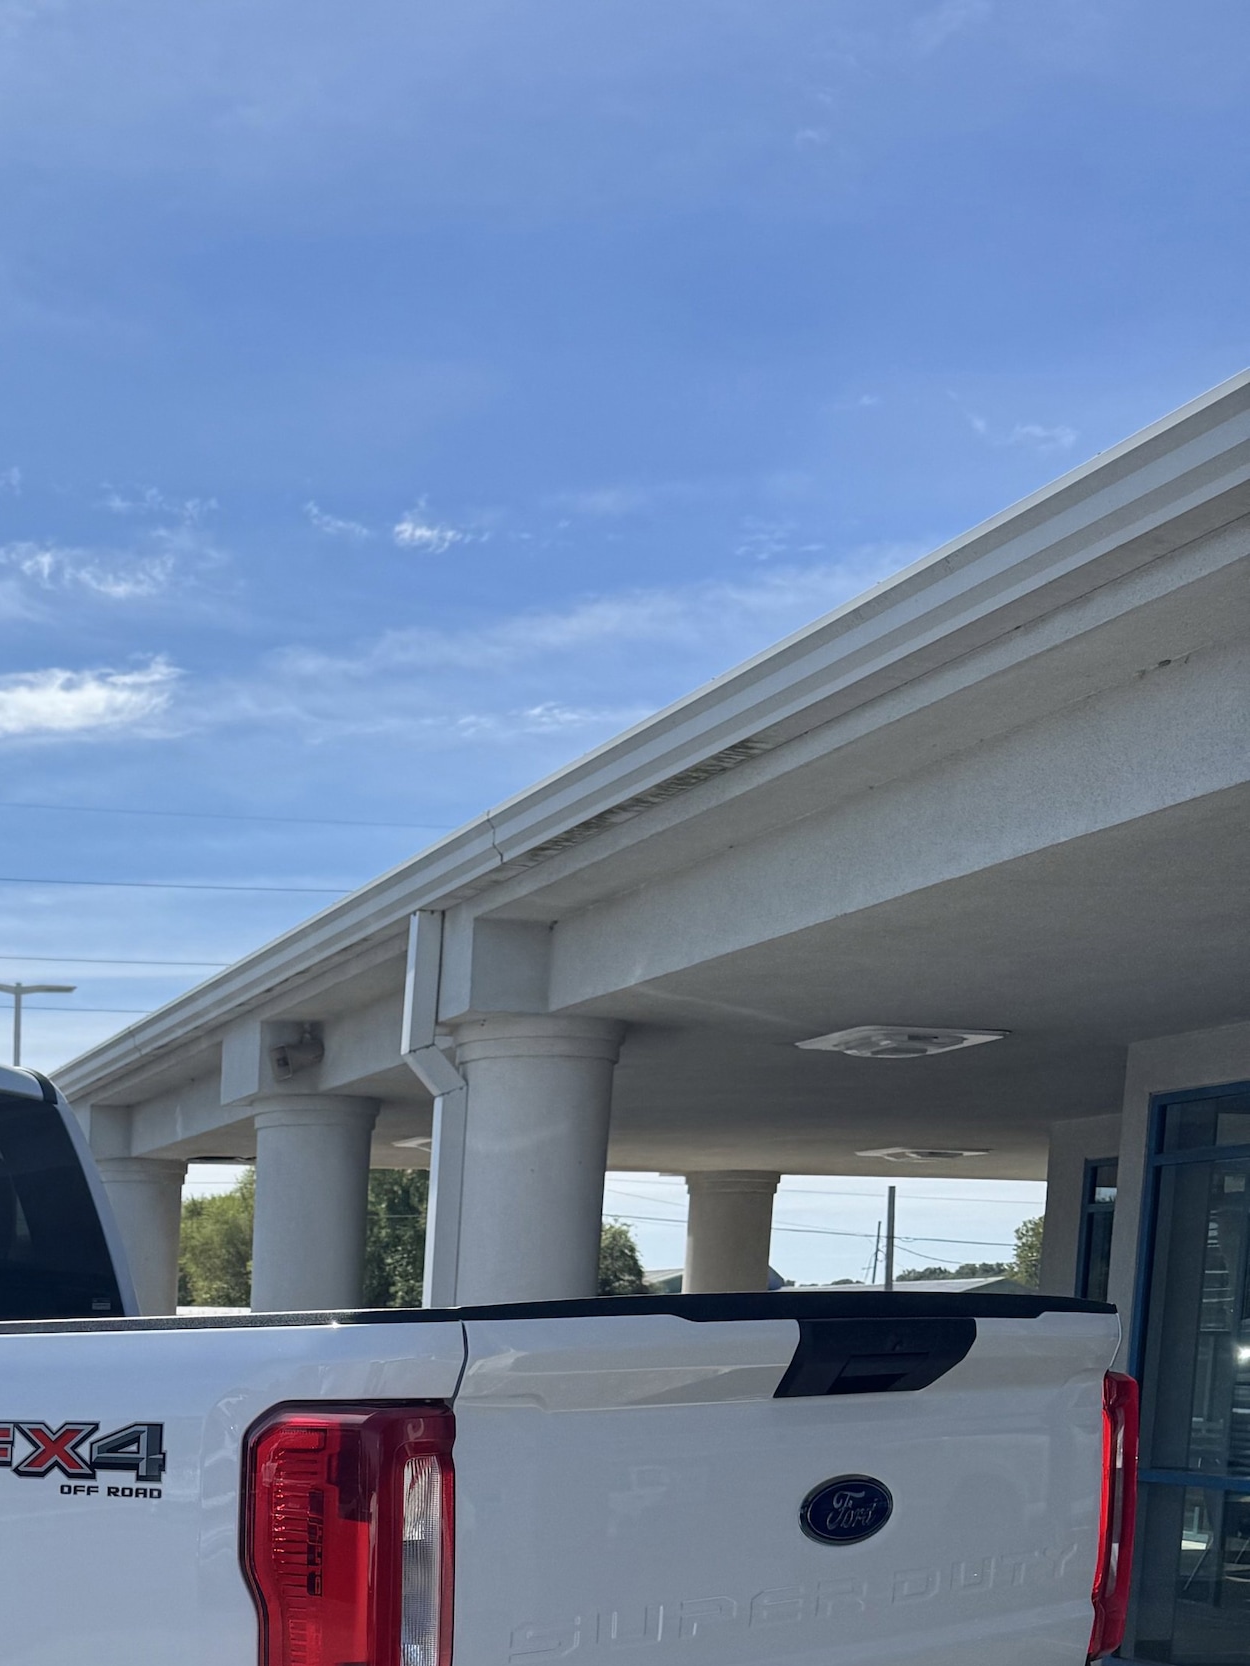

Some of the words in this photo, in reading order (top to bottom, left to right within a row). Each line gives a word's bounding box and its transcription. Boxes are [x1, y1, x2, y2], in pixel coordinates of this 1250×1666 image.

[60, 1484, 99, 1496] OFF
[106, 1486, 162, 1499] ROAD
[826, 1490, 879, 1531] Ford
[508, 1576, 868, 1663] SUPER
[891, 1543, 1079, 1605] DUTY
